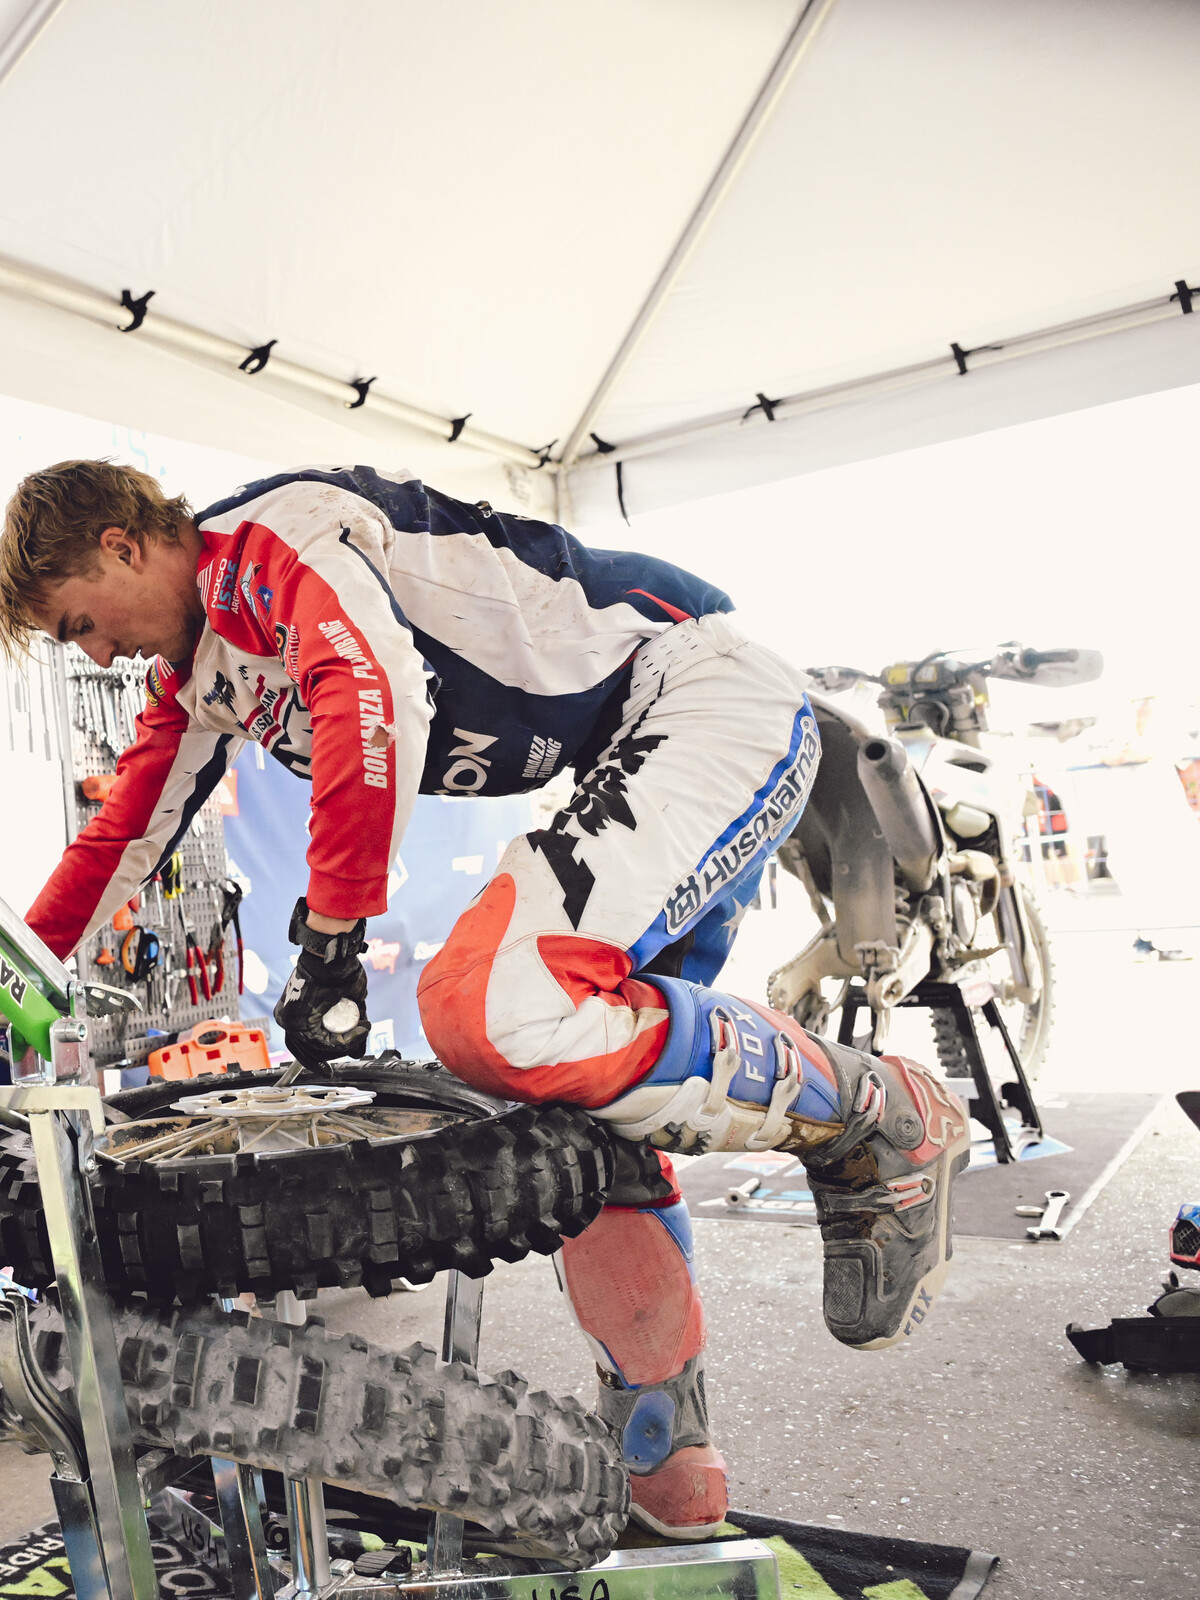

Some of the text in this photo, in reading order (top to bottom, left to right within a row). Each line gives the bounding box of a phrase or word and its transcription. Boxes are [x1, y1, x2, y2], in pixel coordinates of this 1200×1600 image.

[211, 558, 228, 608] NOCO
[357, 689, 388, 789] BONANZA
[522, 735, 547, 778] BONANZA
[536, 737, 562, 778] PLUMBING
[704, 732, 817, 894] Husqvarna
[728, 1005, 766, 1083] FOX
